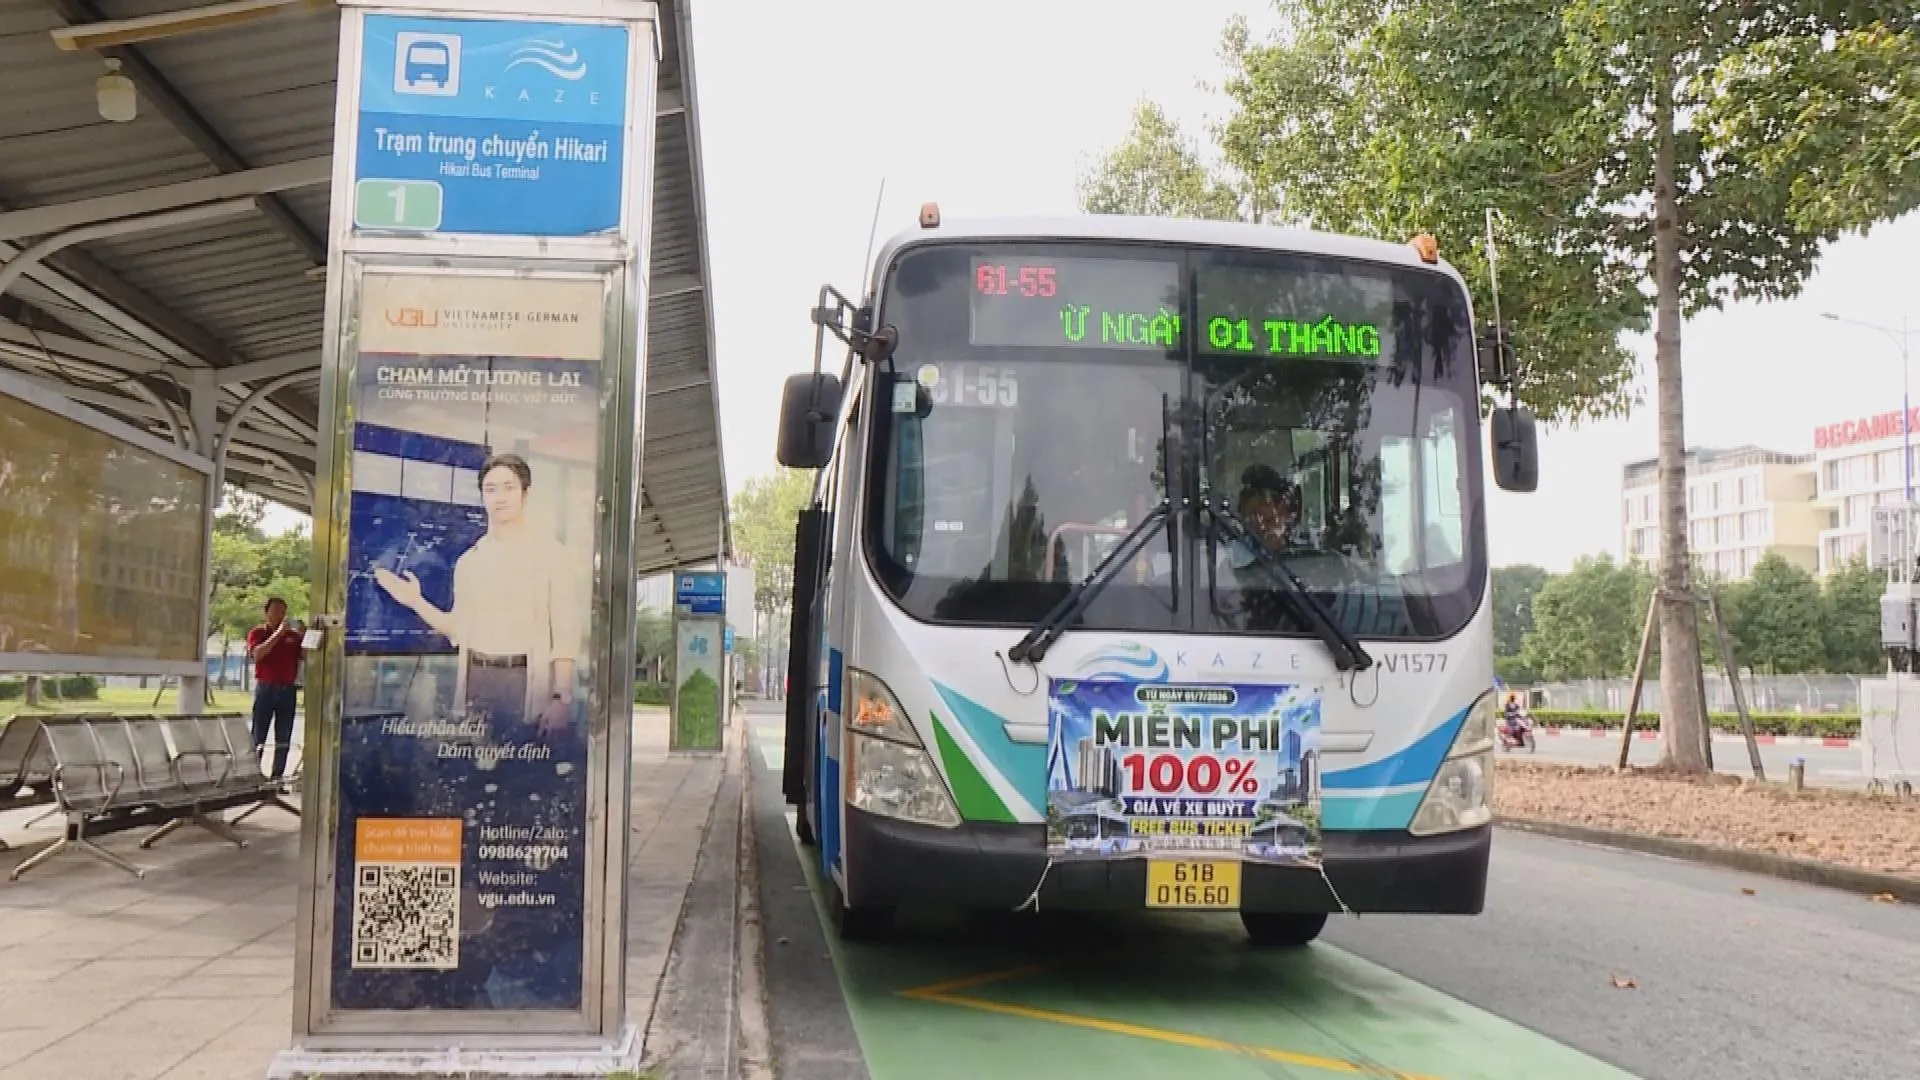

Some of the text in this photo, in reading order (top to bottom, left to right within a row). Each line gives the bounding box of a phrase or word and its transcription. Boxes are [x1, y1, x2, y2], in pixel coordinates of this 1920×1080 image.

[484, 86, 601, 105] KAZE
[374, 127, 607, 163] Trạm trung chuyển Hikari
[439, 161, 540, 181] Hikari Bus Terminal
[387, 185, 406, 223] 1
[976, 264, 1057, 297] 61-55
[443, 309, 521, 322] VIETNAMESE
[527, 311, 579, 324] GERMAN
[1208, 316, 1255, 352] 01
[1263, 313, 1380, 355] THÁNG
[547, 371, 581, 388] LAI
[1176, 650, 1301, 670] KAZE
[1383, 653, 1448, 673] V1577
[381, 715, 418, 735] Hiểu
[417, 717, 457, 739] phân
[1094, 702, 1280, 751] MIỄN PHÍ
[437, 740, 551, 763] Dám quyết định
[1123, 753, 1258, 795] 100%
[1185, 801, 1204, 815] XE
[480, 823, 569, 843] Hotline/Zalo:
[1131, 818, 1252, 837] FREE BUS TICKET
[479, 870, 538, 886] Website:
[1174, 863, 1214, 882] 61B
[477, 889, 556, 909] vgu.edu.vn
[1157, 885, 1230, 905] 016.60
